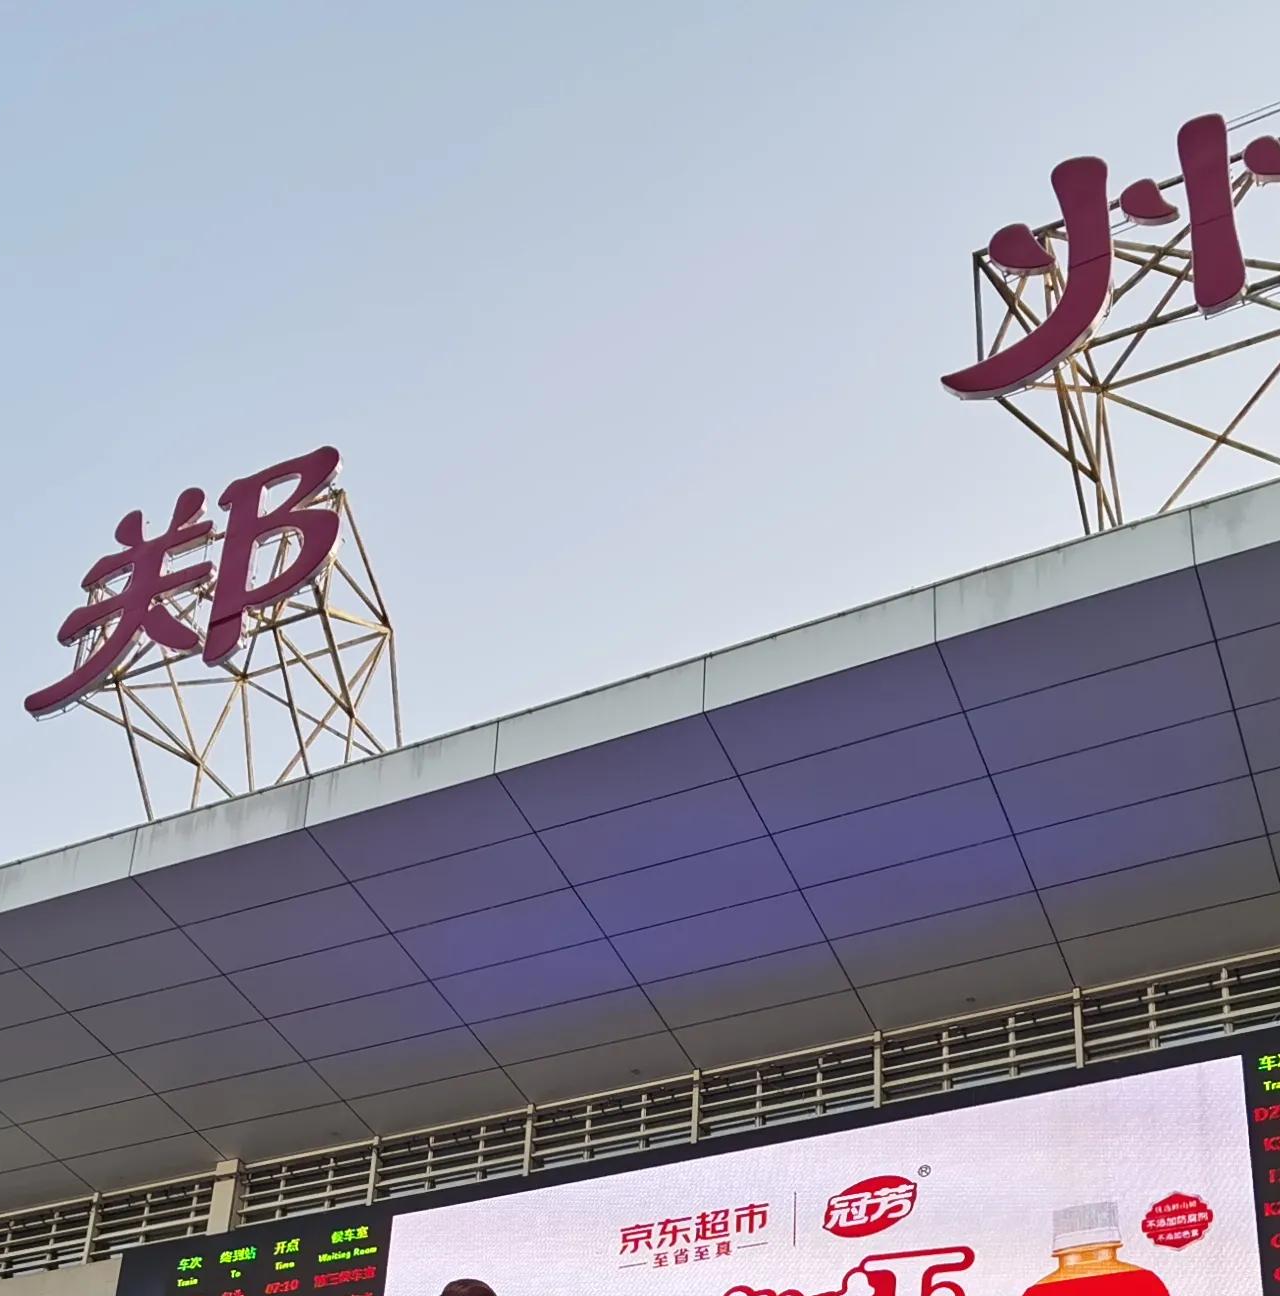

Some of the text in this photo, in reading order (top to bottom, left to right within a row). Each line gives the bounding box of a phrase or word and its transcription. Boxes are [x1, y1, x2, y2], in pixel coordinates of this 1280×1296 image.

[24, 445, 343, 720] 郑
[618, 1202, 771, 1256] 京东超市
[822, 1181, 917, 1232] 冠芳
[177, 1225, 369, 1272] 车次 终到站 开点 候车室
[652, 1242, 733, 1269] 至省至真
[230, 1269, 242, 1279] To
